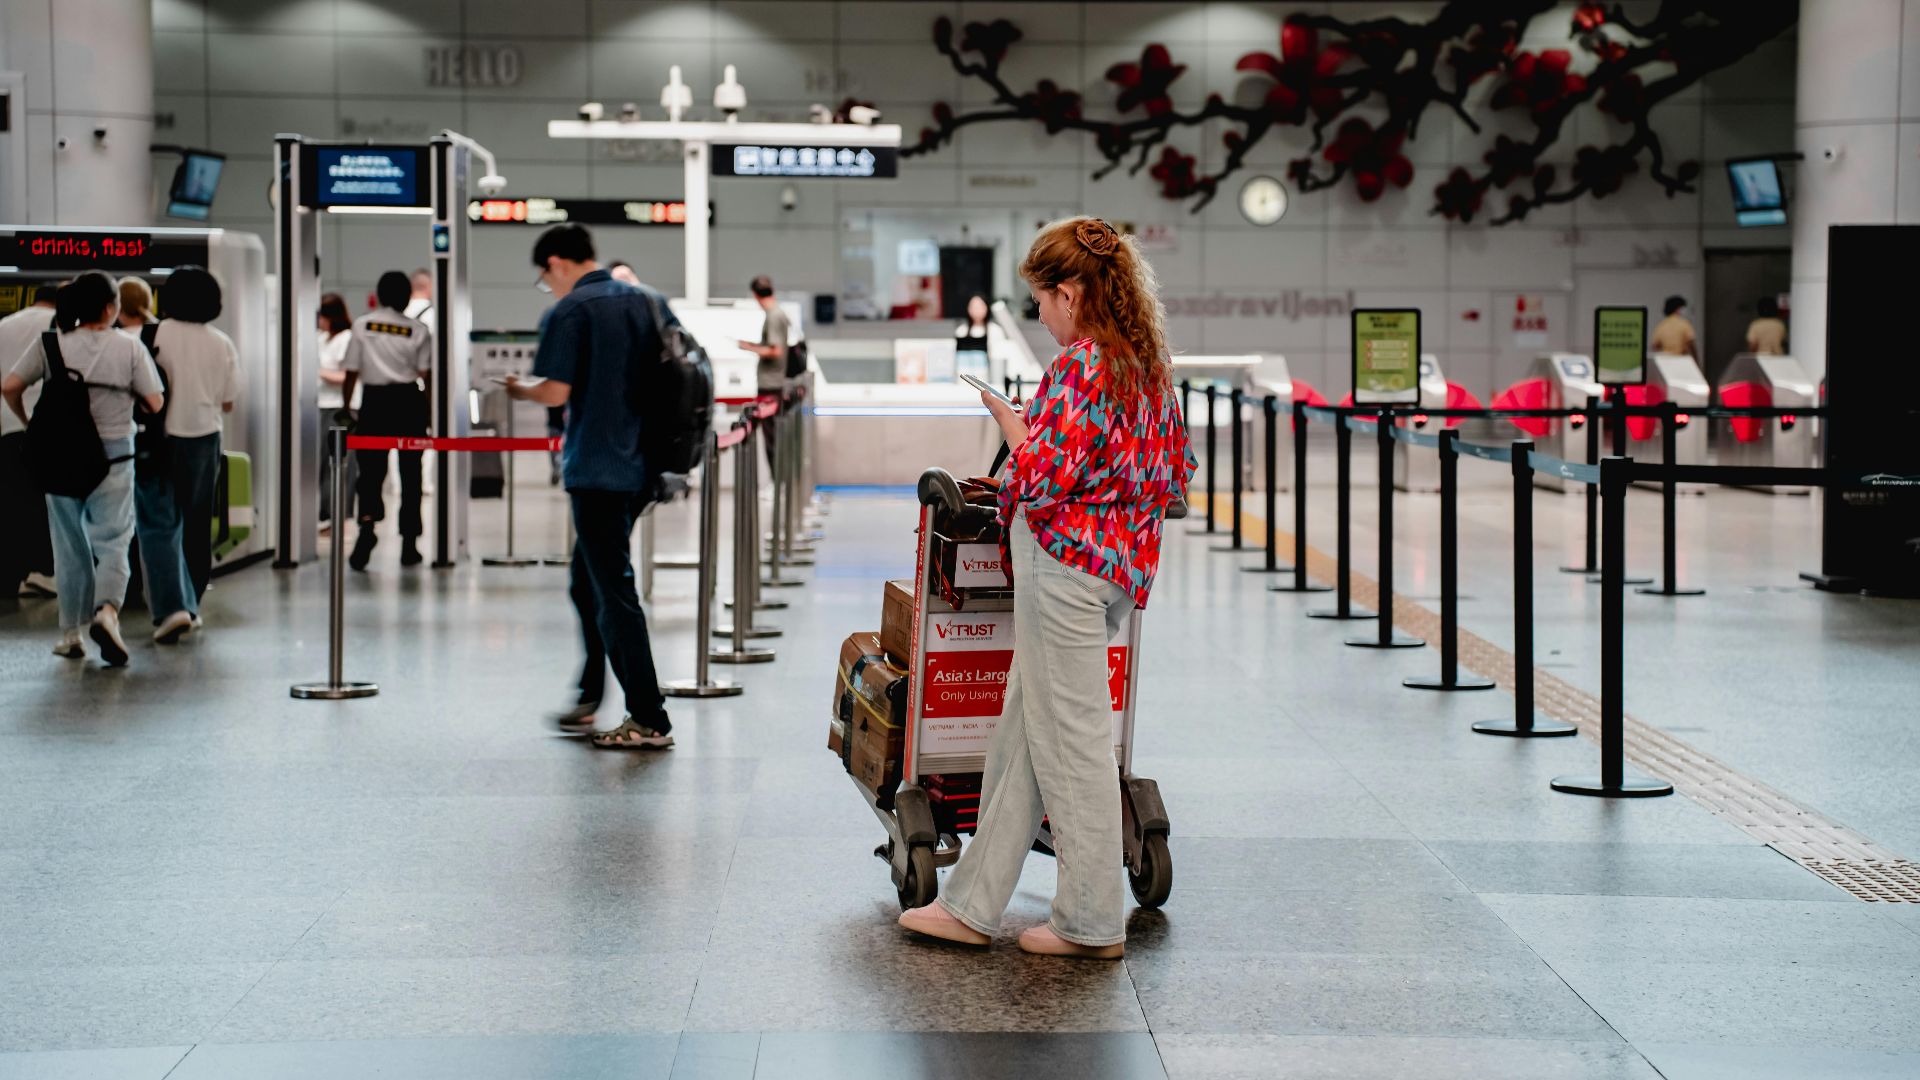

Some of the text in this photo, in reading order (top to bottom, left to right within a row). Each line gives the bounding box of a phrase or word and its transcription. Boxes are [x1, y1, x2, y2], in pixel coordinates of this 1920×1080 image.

[425, 45, 522, 87] HELLO
[31, 236, 97, 259] drinks,
[933, 669, 973, 683] Asia's
[940, 691, 966, 703] Only
[969, 690, 998, 702] Using
